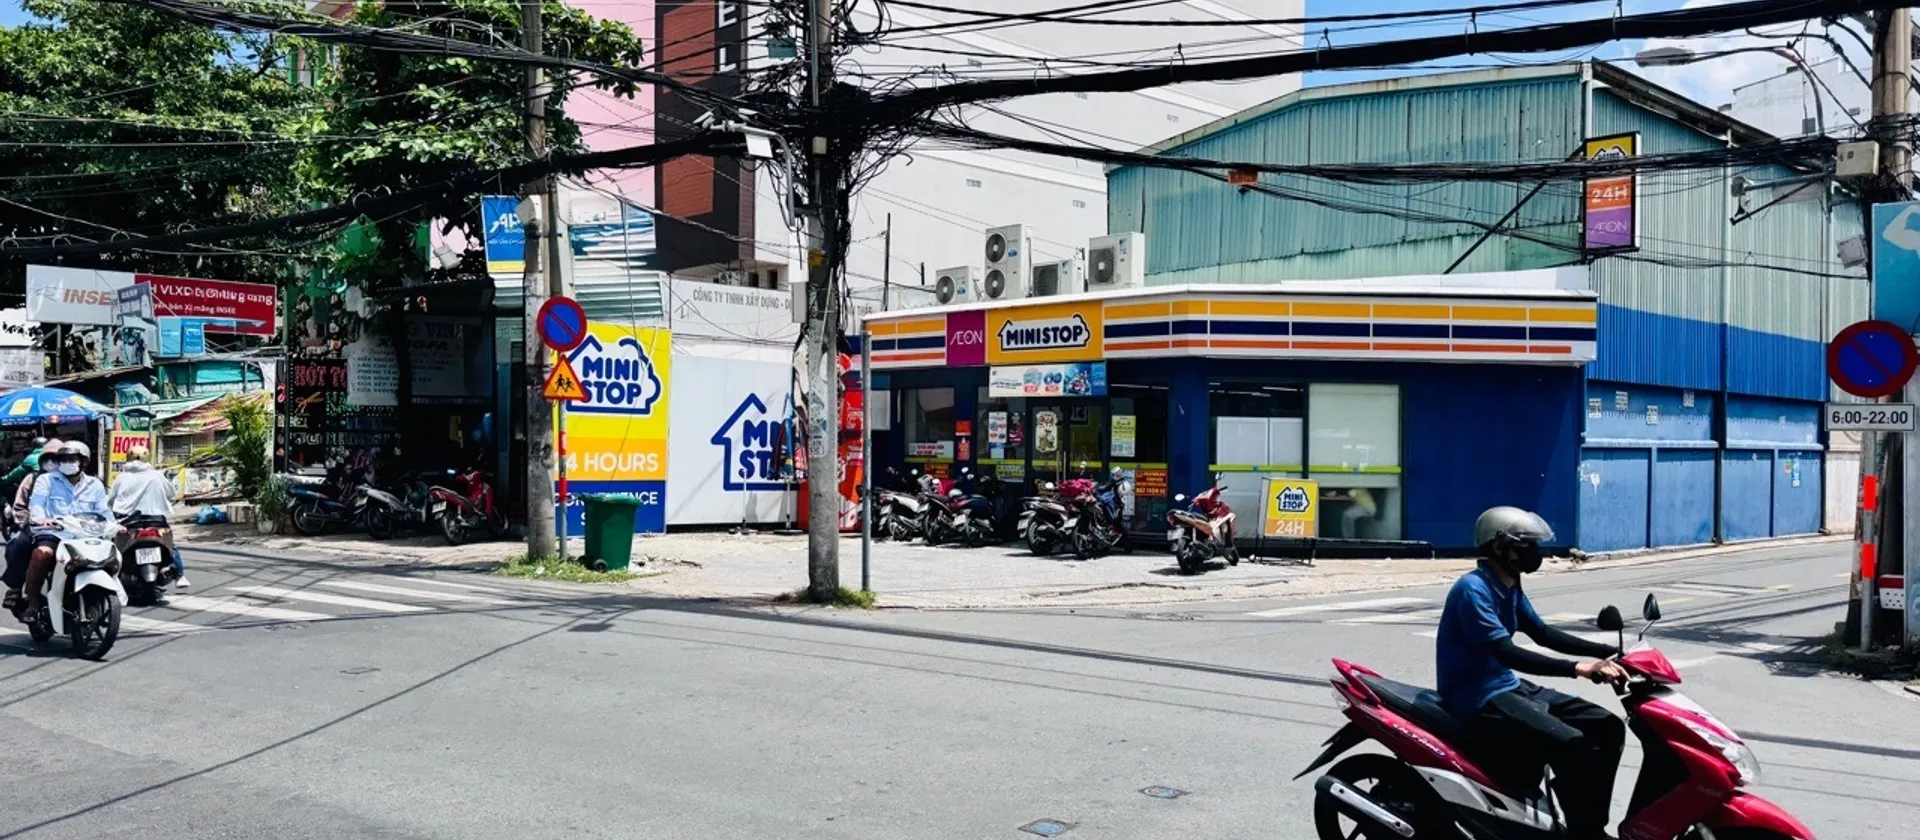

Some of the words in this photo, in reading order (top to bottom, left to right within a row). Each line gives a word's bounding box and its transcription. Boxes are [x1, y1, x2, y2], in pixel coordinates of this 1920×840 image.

[1591, 185, 1628, 203] 24H
[692, 287, 713, 302] CÔNG
[714, 291, 723, 303] TY
[1005, 324, 1083, 346] MINISTOP
[582, 356, 639, 381] MINI
[581, 380, 642, 405] STOP
[1832, 408, 1908, 425] 6:00-22:00
[584, 453, 659, 472] HOURS
[1283, 501, 1304, 509] STOP
[1284, 493, 1304, 501] MINI
[1276, 519, 1305, 535] 24H
